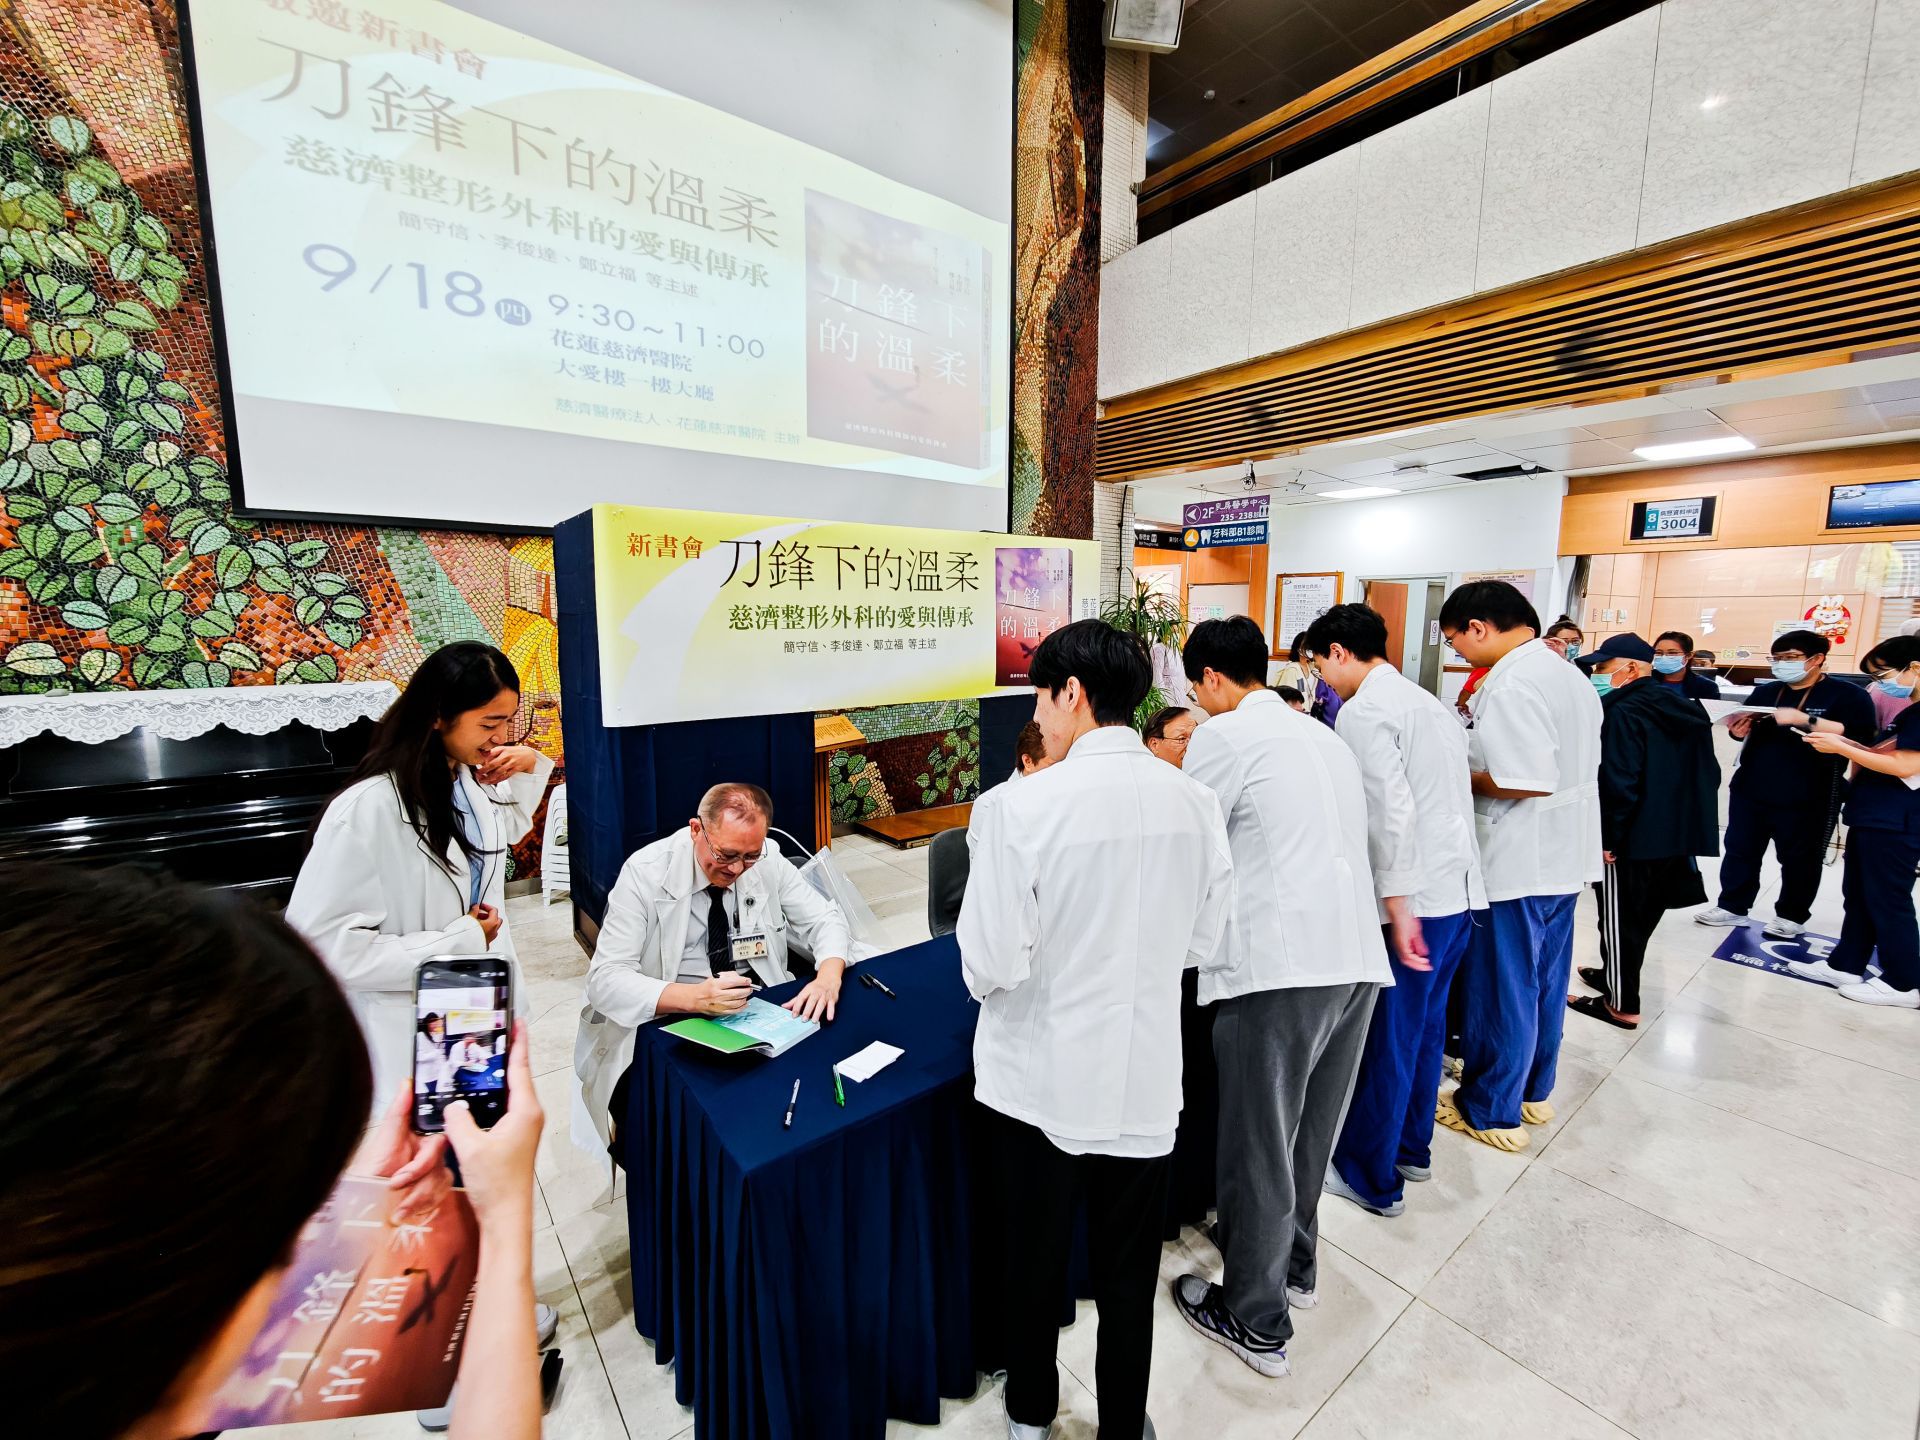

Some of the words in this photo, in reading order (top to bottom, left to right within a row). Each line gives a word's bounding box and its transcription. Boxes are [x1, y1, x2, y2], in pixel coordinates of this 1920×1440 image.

[257, 36, 781, 250] 刀鋒下的溫柔
[282, 134, 771, 290] 慈濟整形外科的愛與傳承
[302, 243, 486, 318] 9/18
[550, 328, 694, 373] 花蓮慈濟醫院
[818, 317, 968, 388] 的溫柔
[554, 357, 716, 402] 大愛樓一樓大廳
[1202, 507, 1215, 519] 2F
[1660, 518, 1697, 530] 3004
[626, 532, 704, 559] 新書會
[718, 538, 981, 592] 刀鋒下的溫柔
[727, 604, 975, 631] 慈濟整形外科的愛與傳承
[783, 638, 905, 654] 簡守信、李俊達、鄭立福
[907, 637, 938, 651] 等主述
